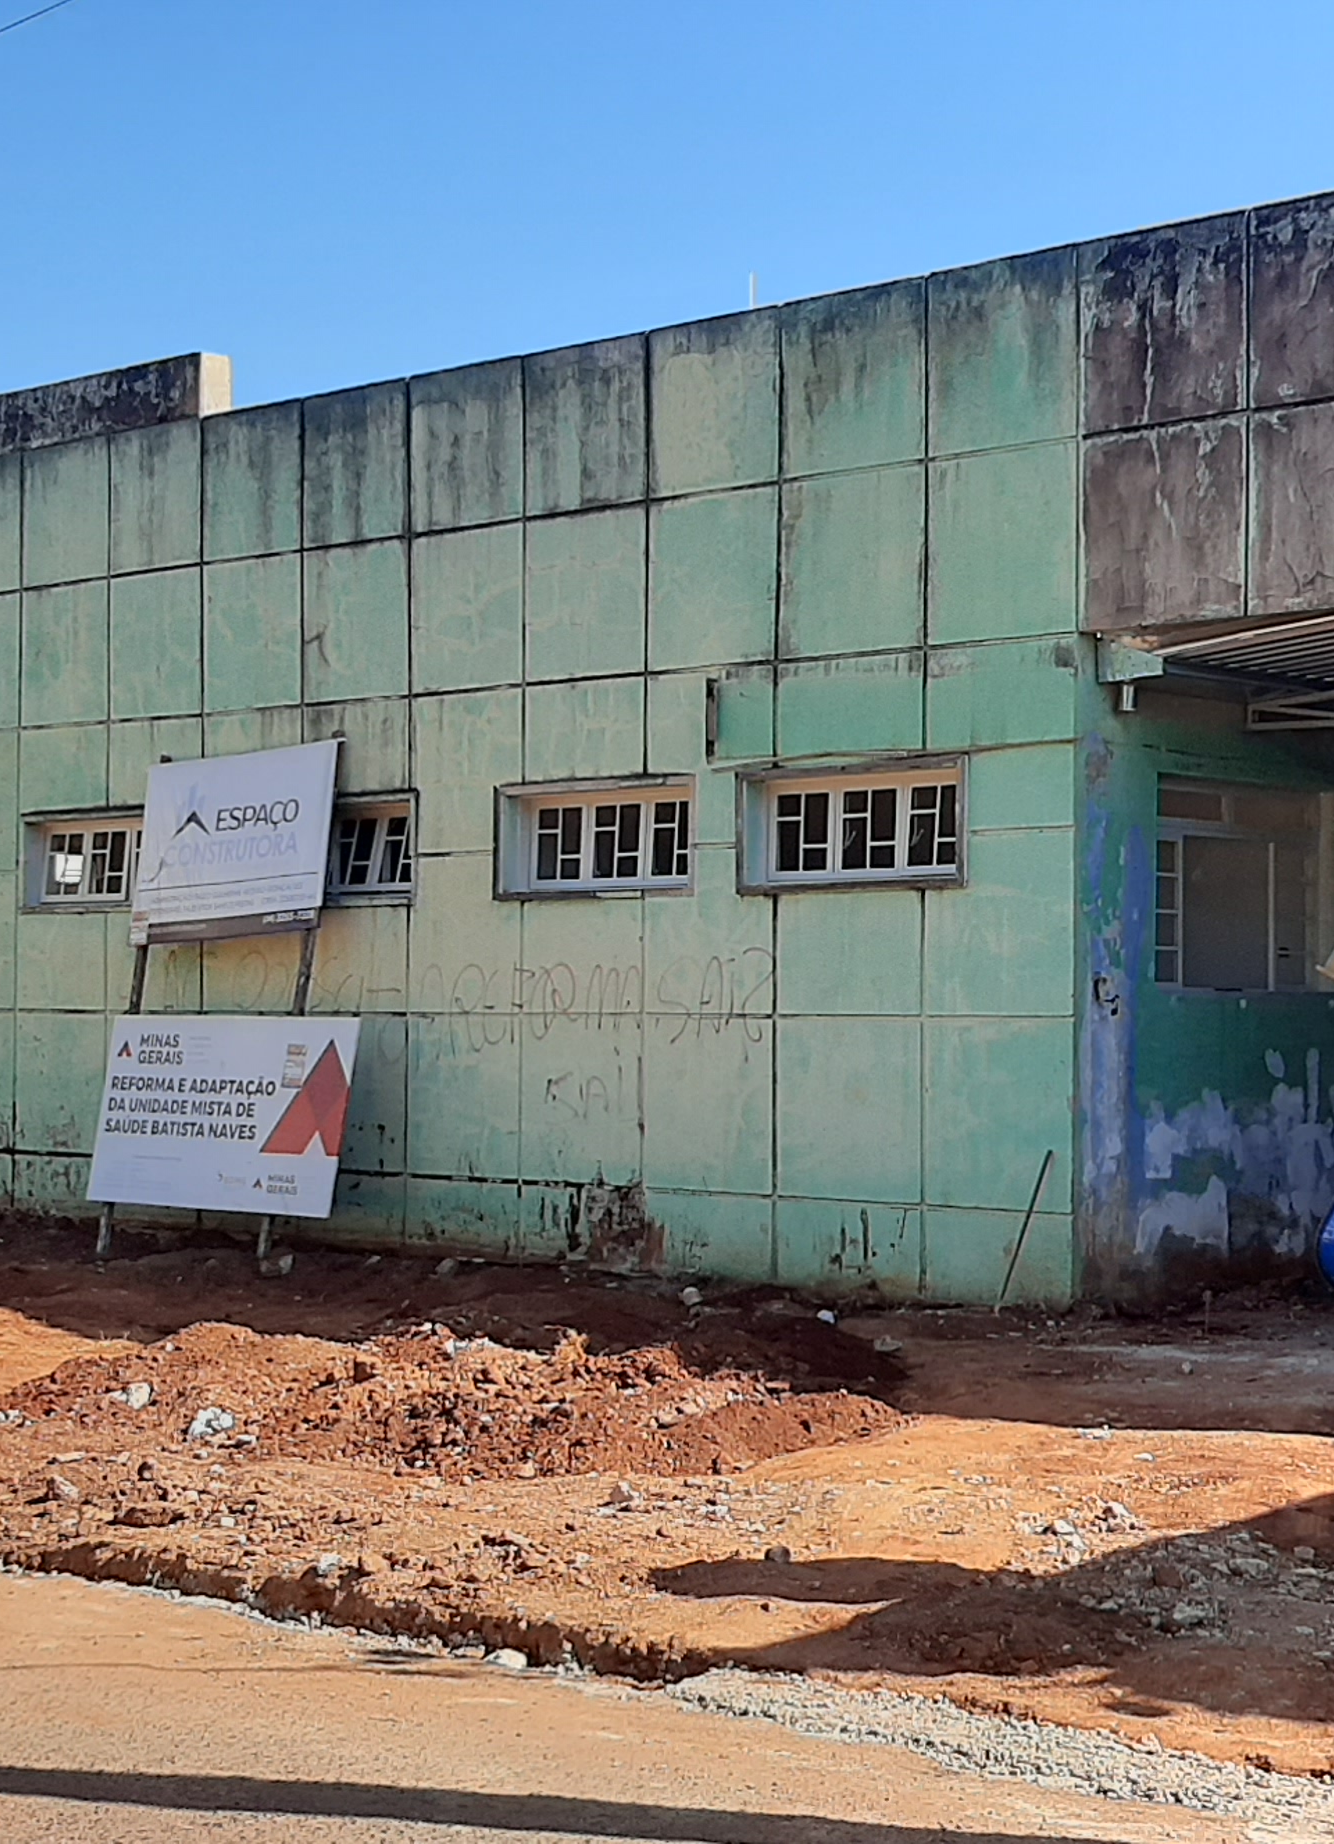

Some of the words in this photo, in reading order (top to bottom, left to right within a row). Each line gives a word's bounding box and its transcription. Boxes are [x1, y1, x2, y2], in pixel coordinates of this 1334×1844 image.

[215, 799, 299, 831] ESPAÇO
[162, 833, 298, 867] CONSTRUTORA
[139, 1034, 180, 1048] MINAS
[138, 1050, 184, 1065] GERAIS
[111, 1076, 174, 1092] REFORMA
[178, 1078, 186, 1092] E
[188, 1076, 276, 1099] ADAPTAÇÃO
[108, 1098, 126, 1112] DA
[129, 1098, 188, 1115] UNIDADE
[191, 1100, 233, 1117] MISTA
[236, 1102, 255, 1118] DE
[104, 1115, 149, 1135] SAÚDE
[151, 1120, 205, 1138] BATISTA
[209, 1124, 256, 1140] NAVES
